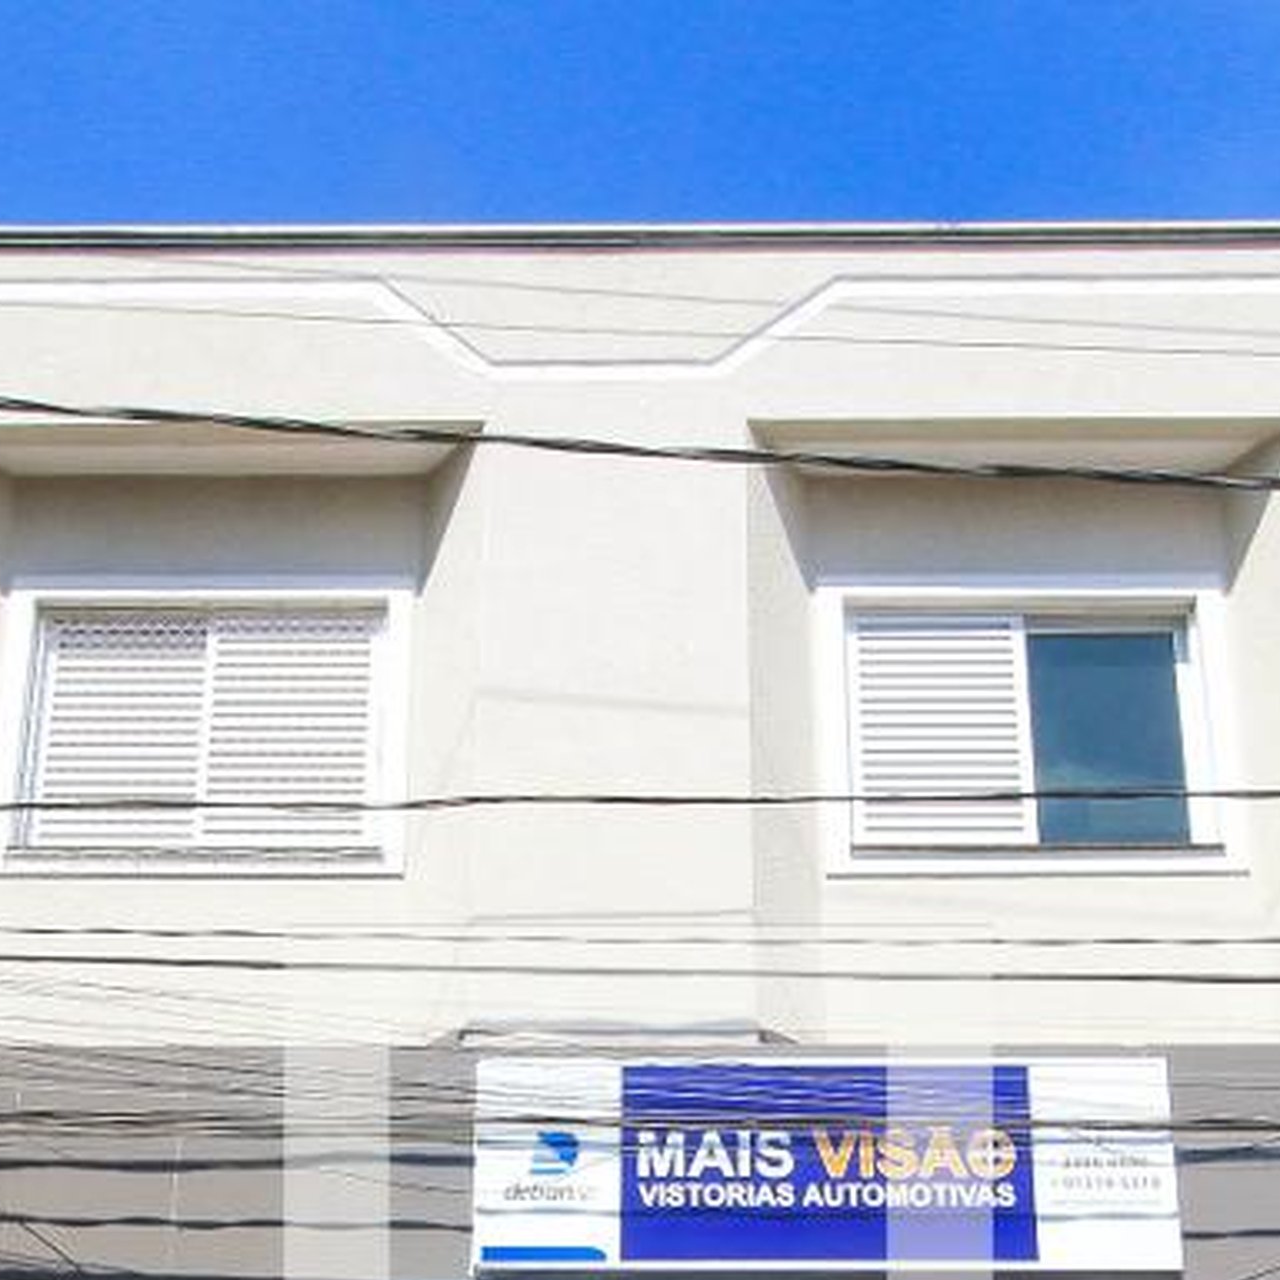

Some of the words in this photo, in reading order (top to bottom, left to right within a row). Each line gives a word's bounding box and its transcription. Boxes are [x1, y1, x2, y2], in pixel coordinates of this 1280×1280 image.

[636, 1129, 795, 1178] MAIS
[637, 1182, 796, 1208] VISTORIAS
[802, 1182, 1017, 1208] AUTOMOTIVAS
